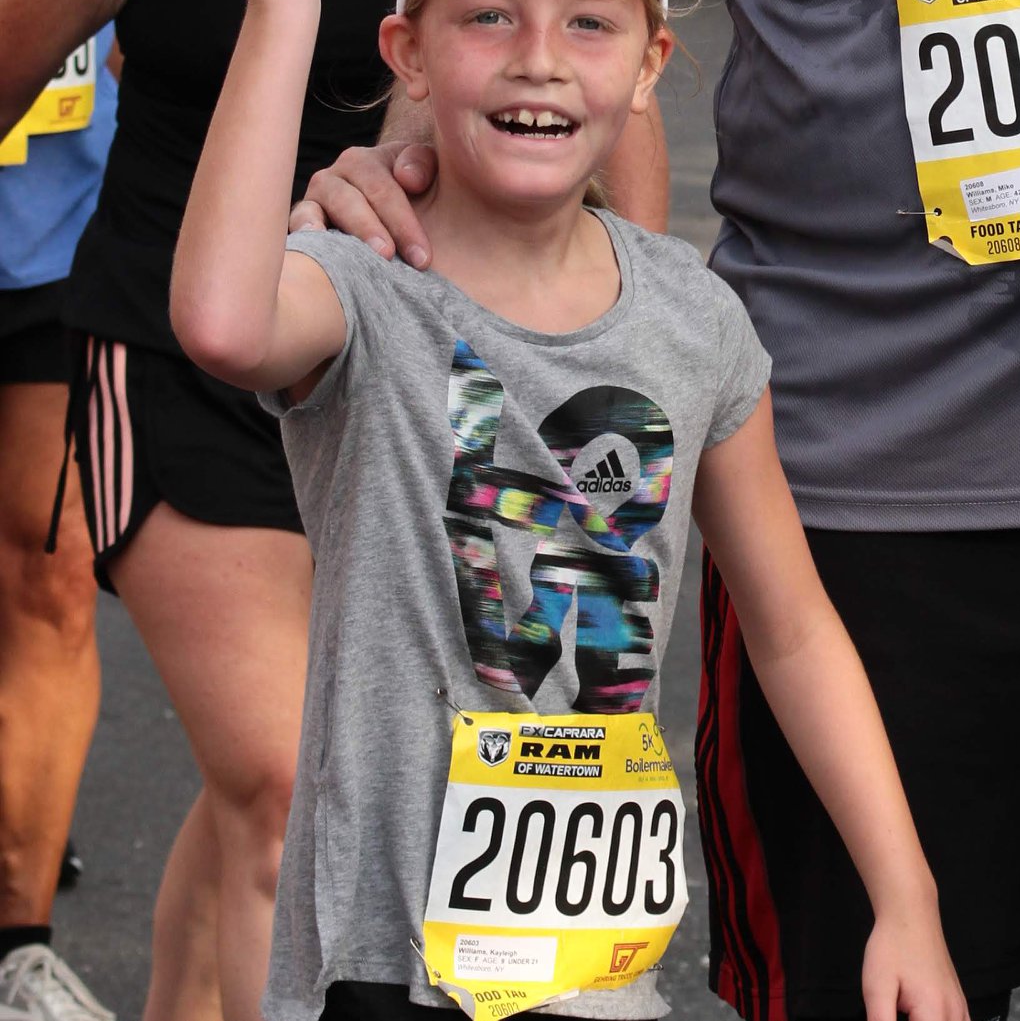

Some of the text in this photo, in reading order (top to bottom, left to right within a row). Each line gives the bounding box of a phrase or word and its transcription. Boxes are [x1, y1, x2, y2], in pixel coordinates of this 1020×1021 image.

[965, 181, 984, 190] 20608
[970, 222, 1005, 238] FOOD
[576, 477, 631, 493] adidas
[544, 726, 605, 739] CAPRARA
[642, 733, 654, 751] 5K
[520, 742, 600, 760] RAM
[517, 763, 600, 777] OF WATERTOWN
[625, 757, 673, 773] Boilermake
[448, 796, 678, 917] 20603
[489, 949, 518, 958] Kayleigh
[609, 941, 650, 973] GT
[475, 990, 502, 1003] OOD
